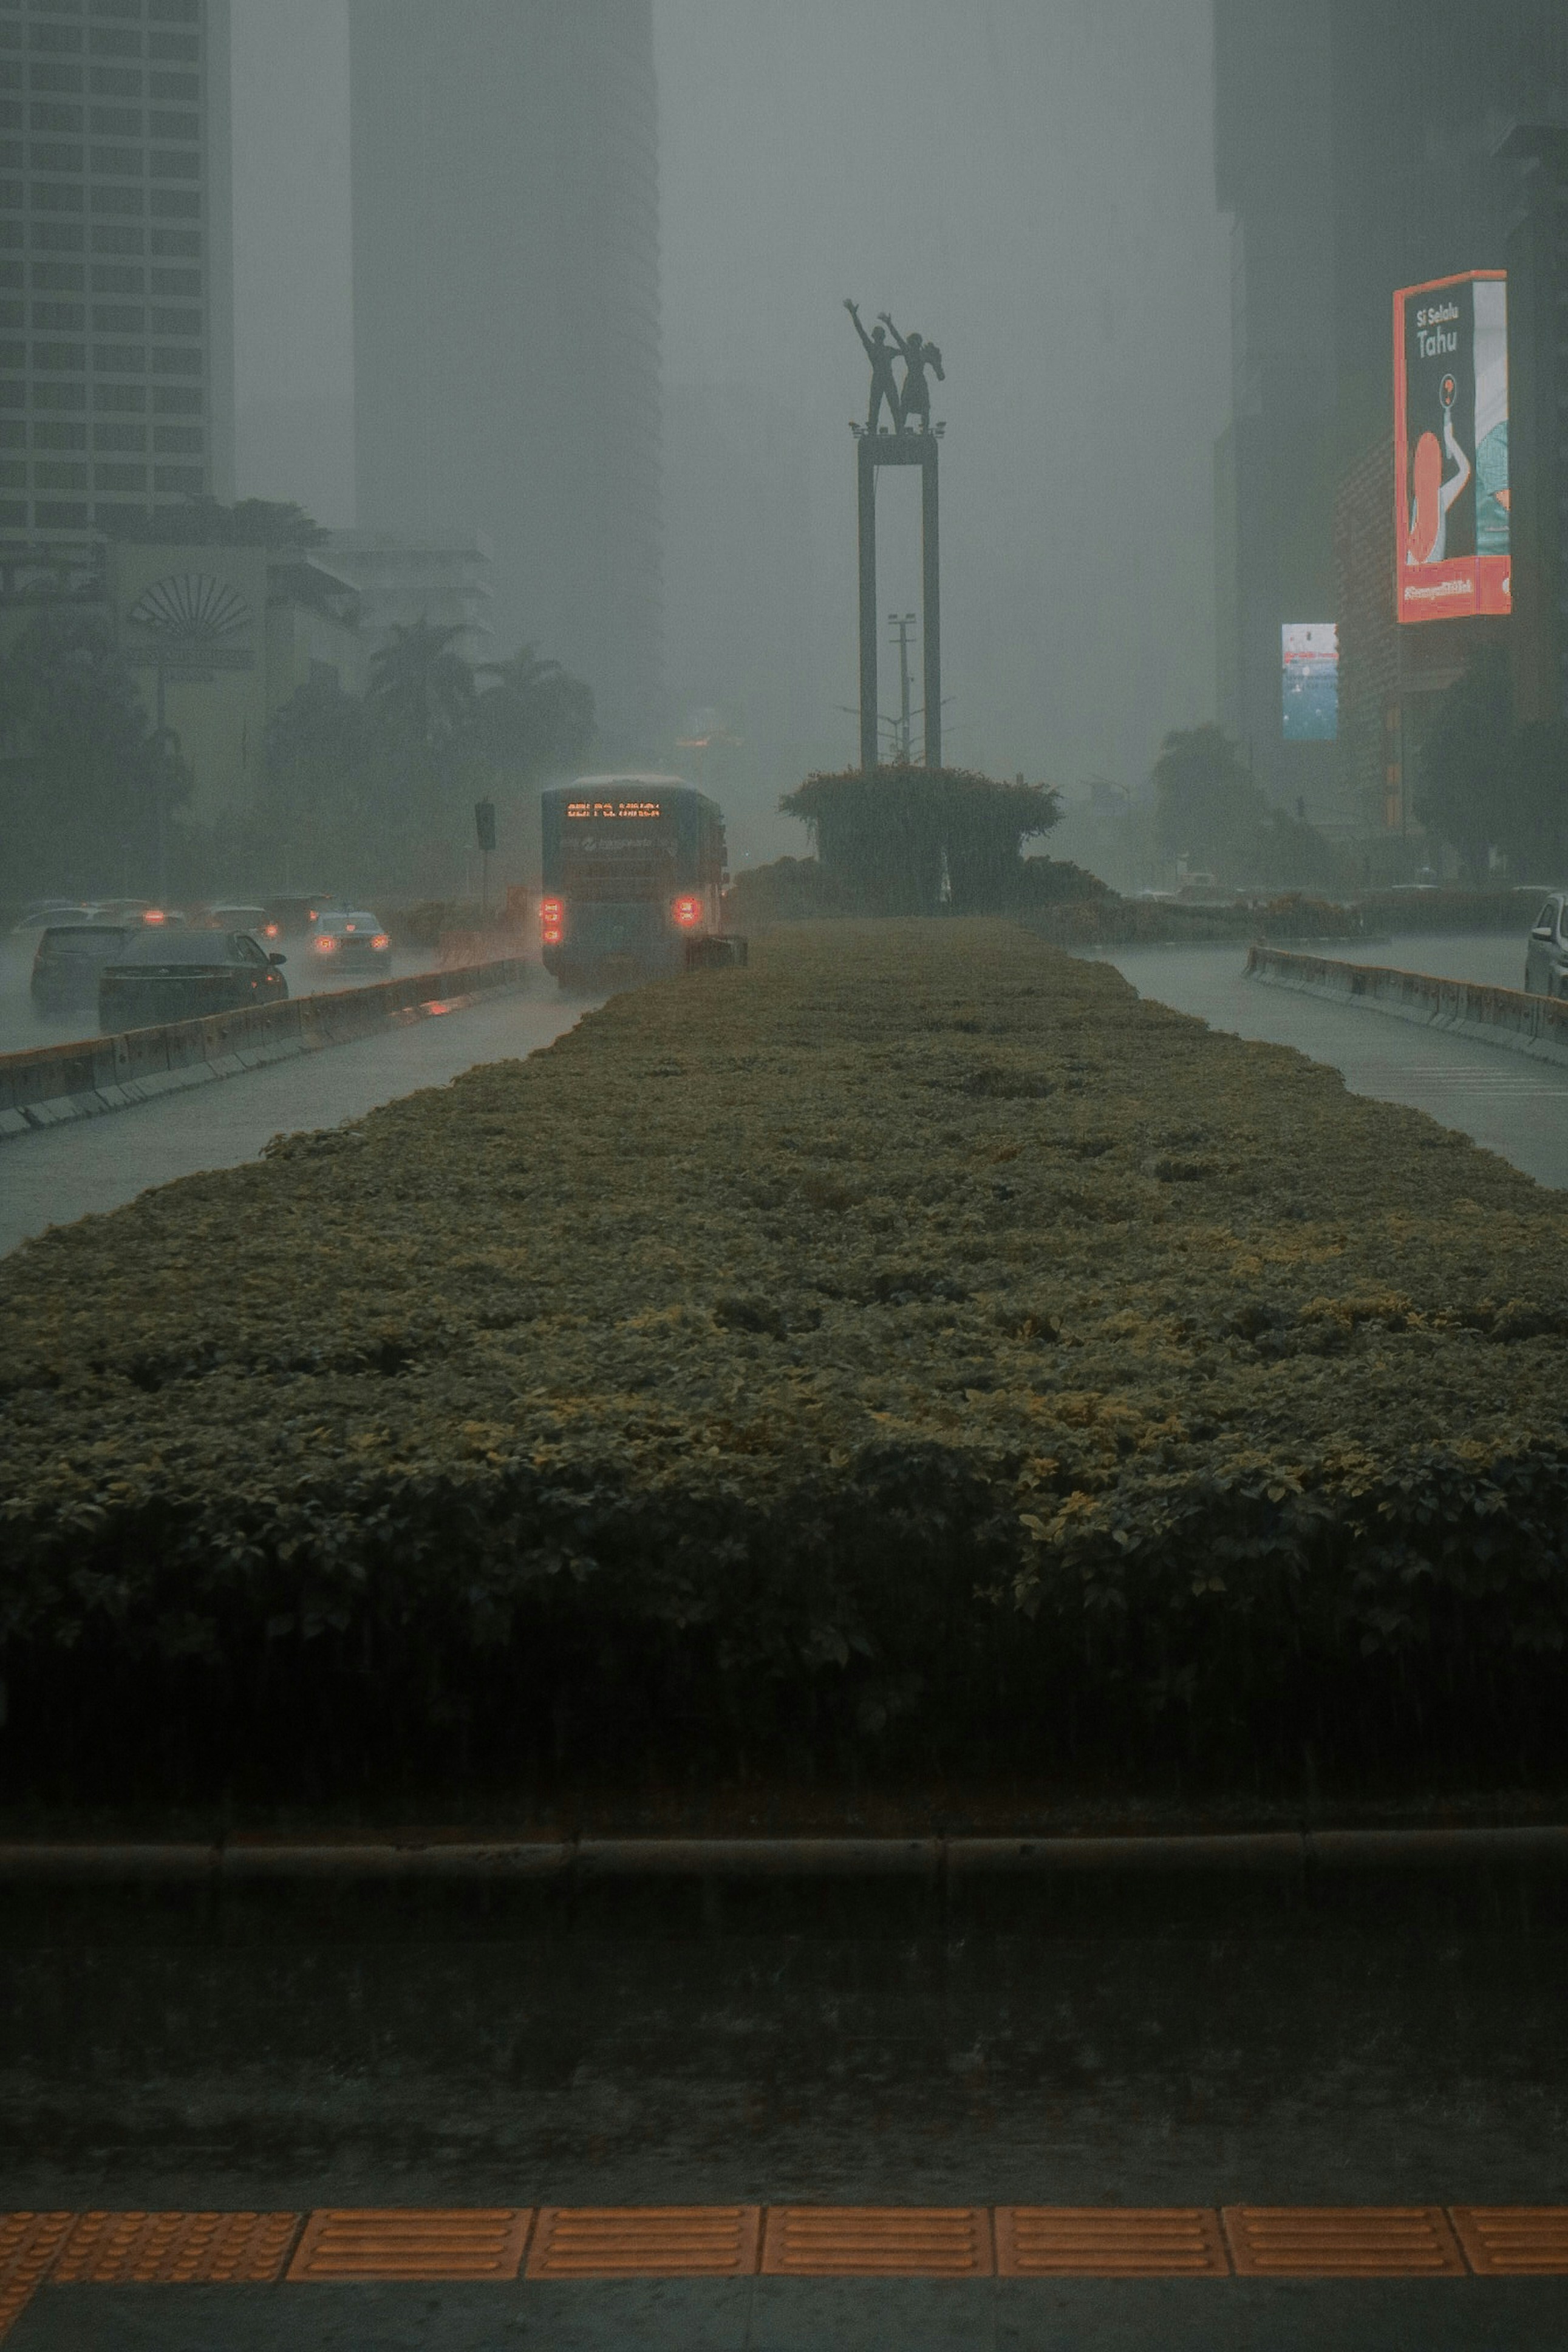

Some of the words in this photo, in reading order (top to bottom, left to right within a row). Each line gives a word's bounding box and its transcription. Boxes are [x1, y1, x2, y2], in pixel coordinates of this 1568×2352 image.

[1417, 310, 1427, 327] Si
[1428, 302, 1459, 324] Selalu
[1417, 326, 1457, 358] Tahu
